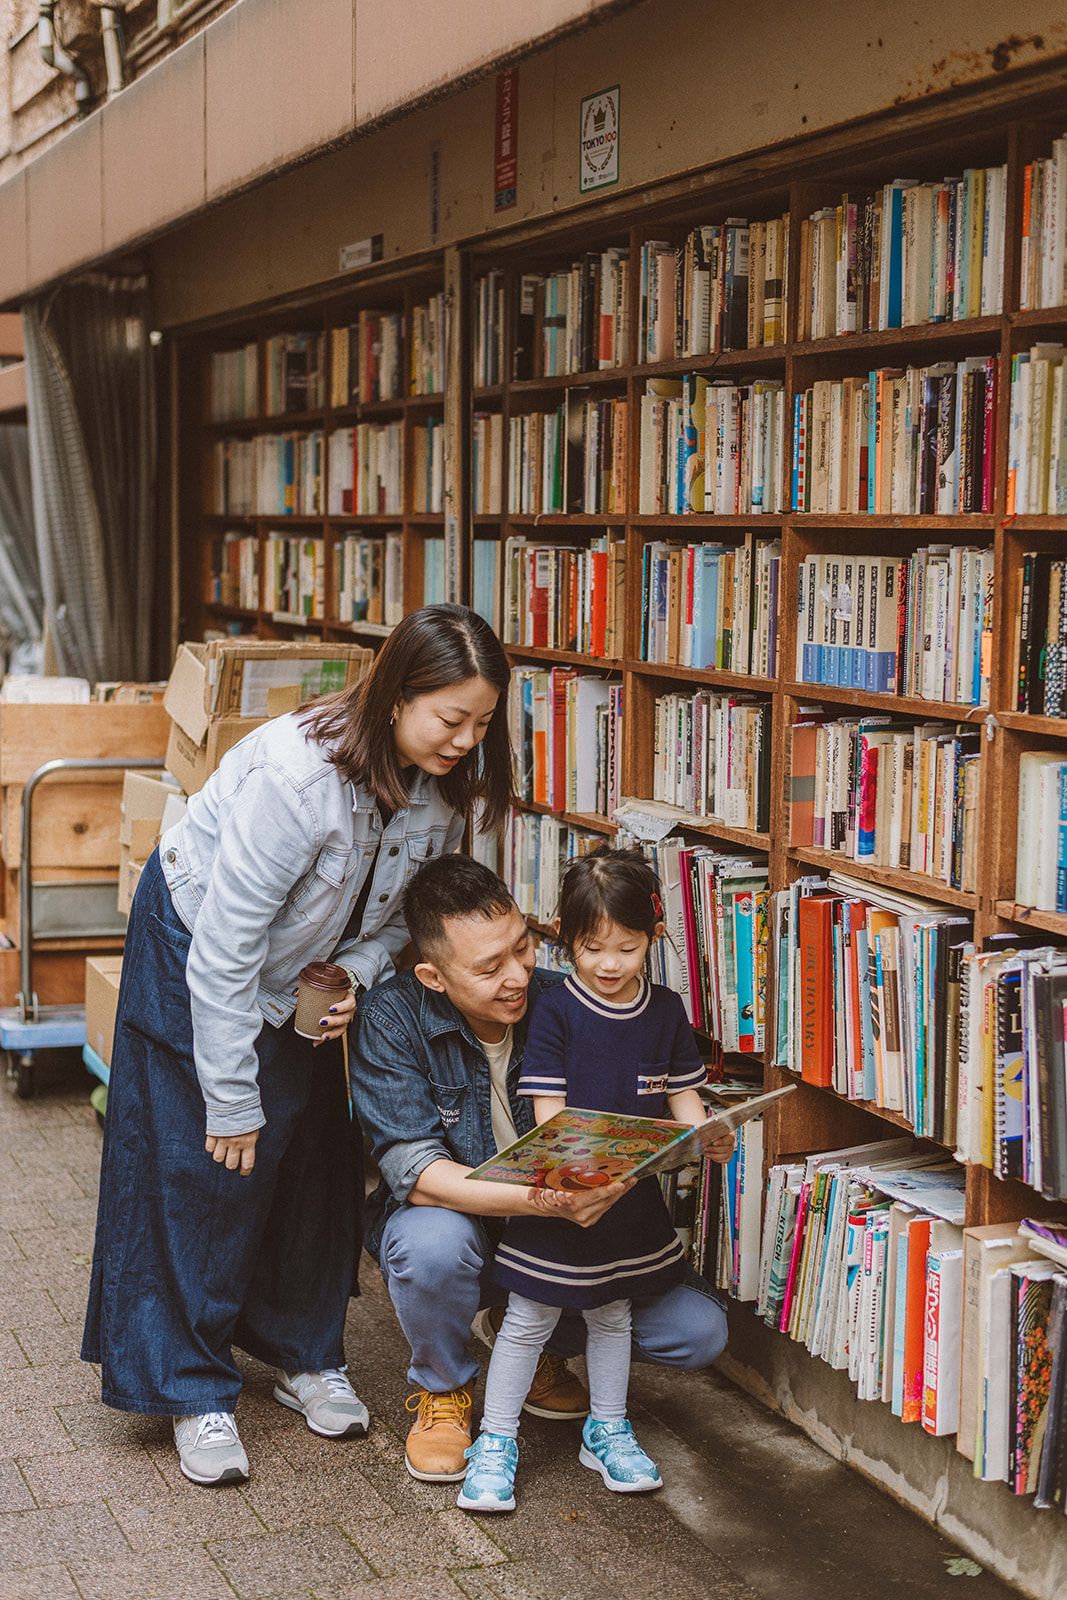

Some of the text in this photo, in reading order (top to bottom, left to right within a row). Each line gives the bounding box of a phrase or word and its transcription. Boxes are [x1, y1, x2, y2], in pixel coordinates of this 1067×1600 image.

[676, 911, 689, 995] Kunio Makino
[804, 945, 817, 1053] DICTIONARY
[774, 1216, 786, 1262] KITSCH
